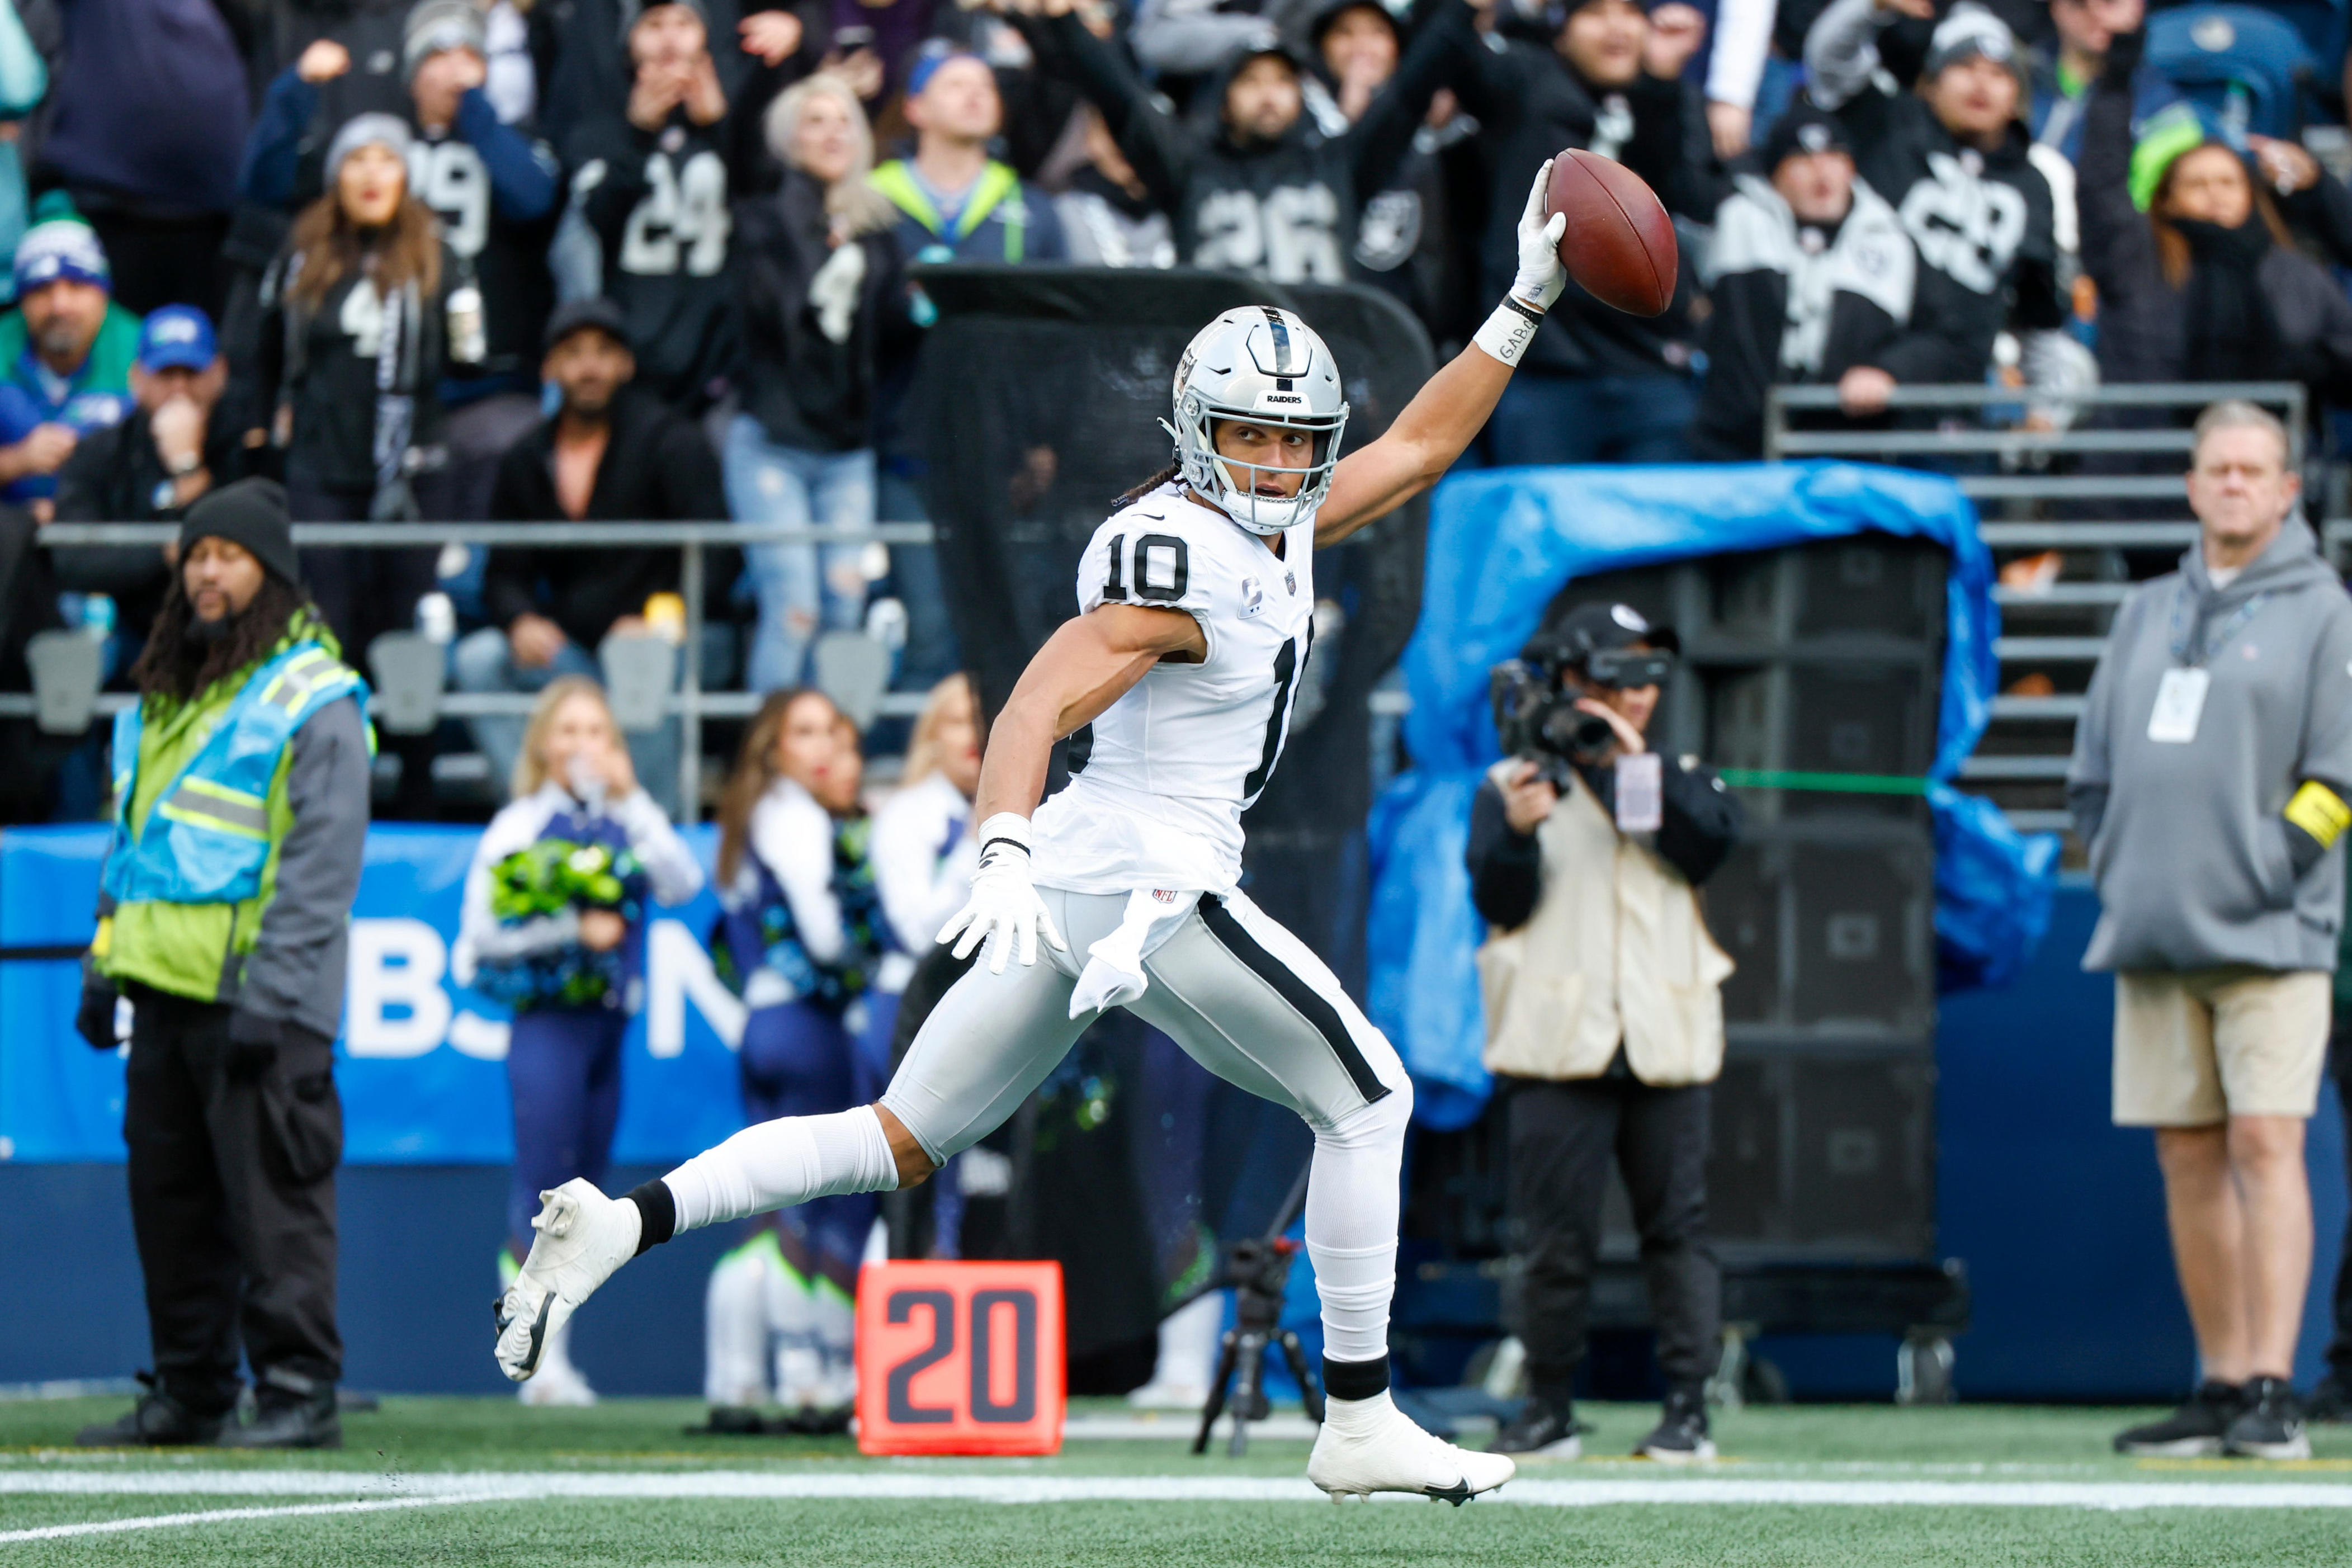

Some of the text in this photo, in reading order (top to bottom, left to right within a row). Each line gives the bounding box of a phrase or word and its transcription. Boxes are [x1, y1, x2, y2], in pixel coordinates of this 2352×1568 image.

[1267, 395, 1302, 404] RAIDERS
[1103, 534, 1188, 602] 10
[1155, 890, 1173, 901] NFL
[887, 1290, 1037, 1424] 20
